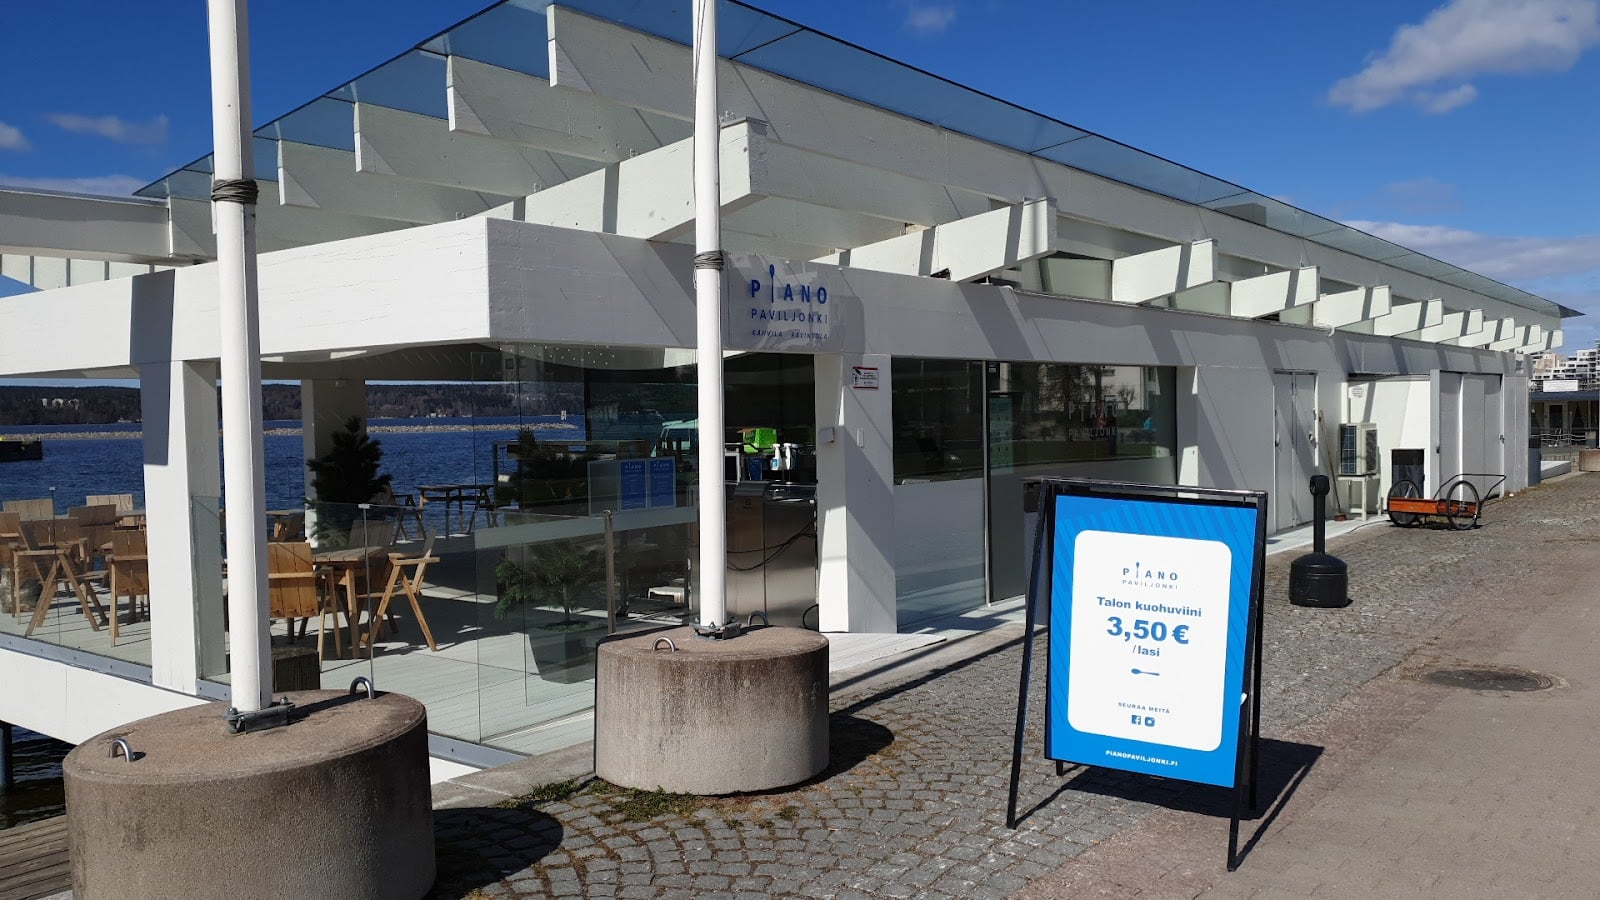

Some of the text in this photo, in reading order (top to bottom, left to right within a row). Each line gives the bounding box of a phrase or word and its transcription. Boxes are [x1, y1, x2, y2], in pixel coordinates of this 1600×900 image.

[751, 264, 828, 304] PIANO
[751, 308, 828, 323] PAVILJONKI
[1122, 561, 1178, 581] PIANO
[1122, 580, 1178, 590] PAVILJONKI
[1096, 596, 1202, 617] Talon kuohuviini
[1106, 616, 1190, 645] 3,50 €
[1118, 702, 1146, 711] SEURAA
[1105, 750, 1178, 766] PIANOPAVILJONKI.FI
